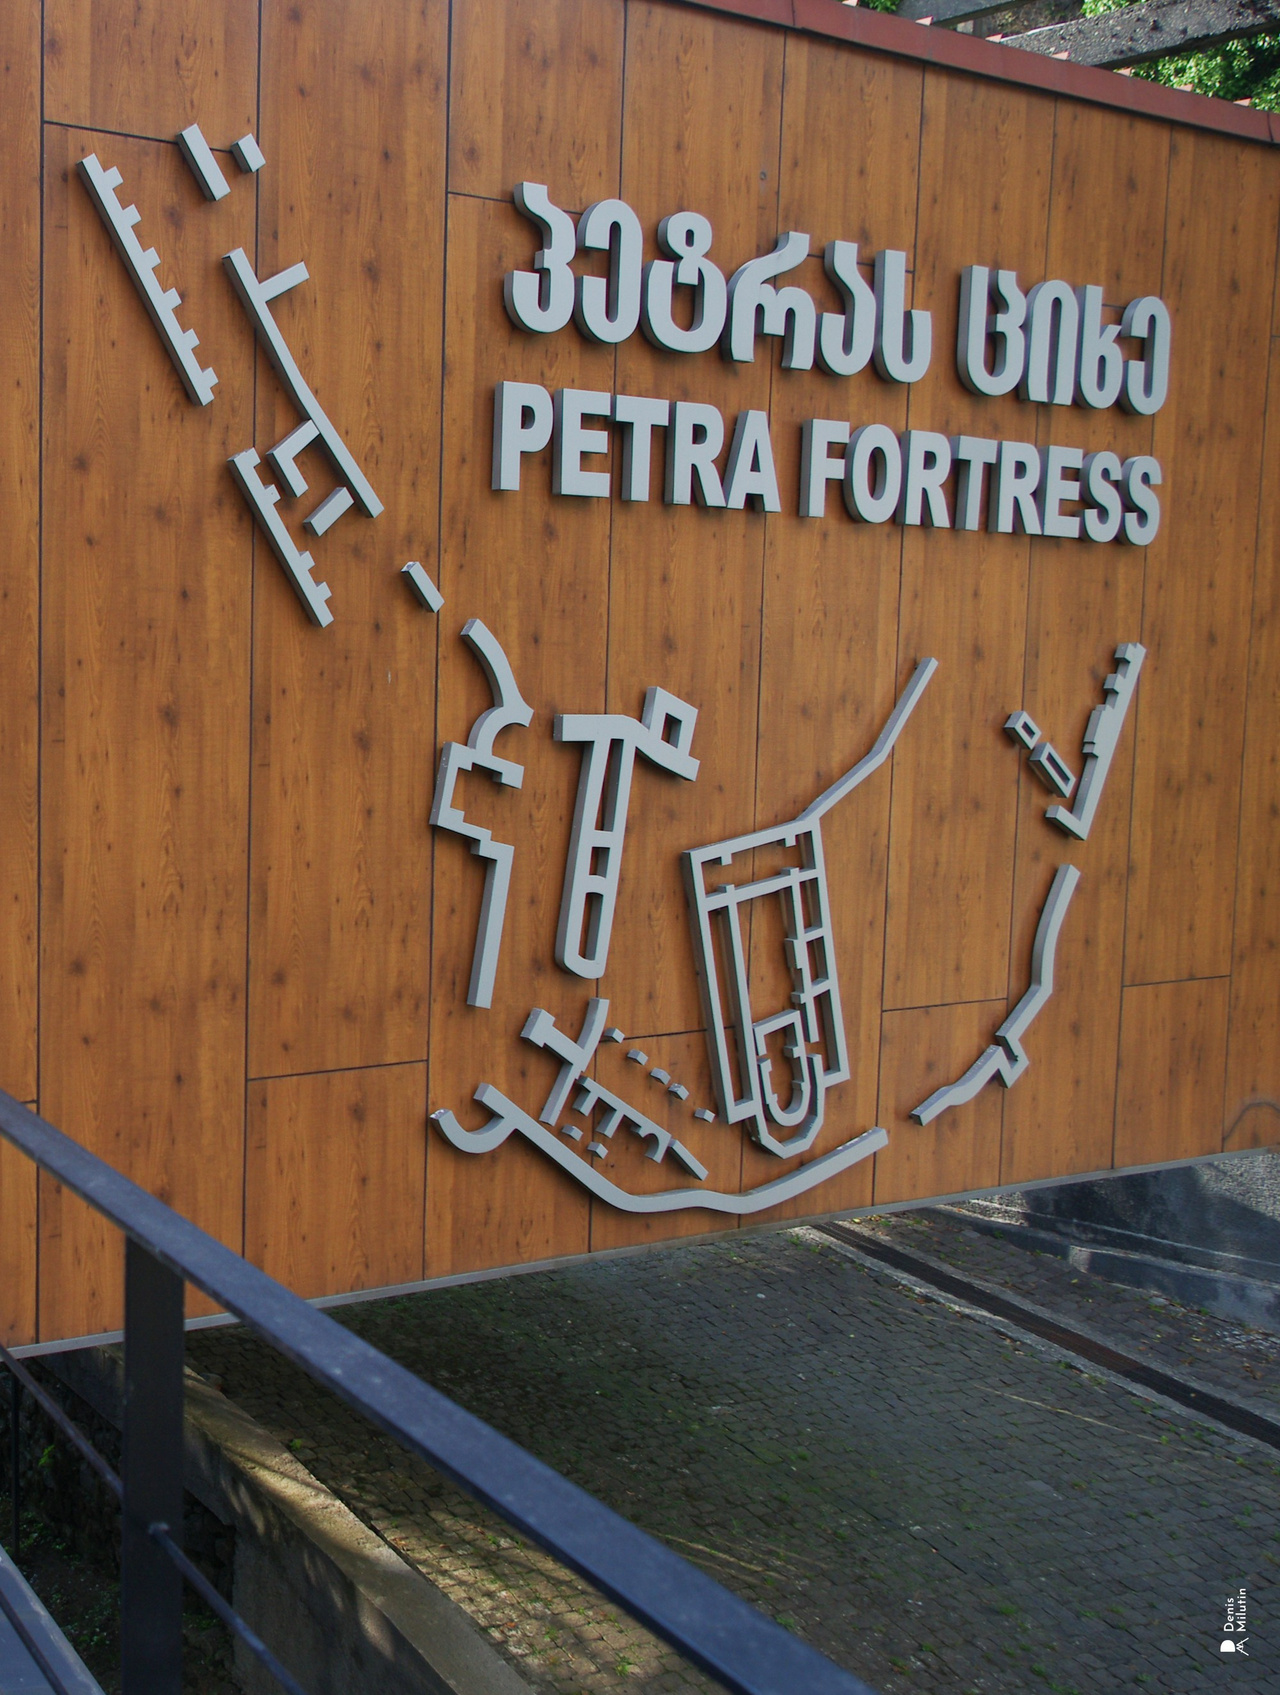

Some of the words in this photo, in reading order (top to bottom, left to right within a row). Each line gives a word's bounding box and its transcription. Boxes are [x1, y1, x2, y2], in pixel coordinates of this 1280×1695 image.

[504, 182, 932, 383] პეტრას
[957, 265, 1171, 416] ციხე
[492, 380, 782, 512] PETRA
[799, 418, 1163, 546] FORTRESS
